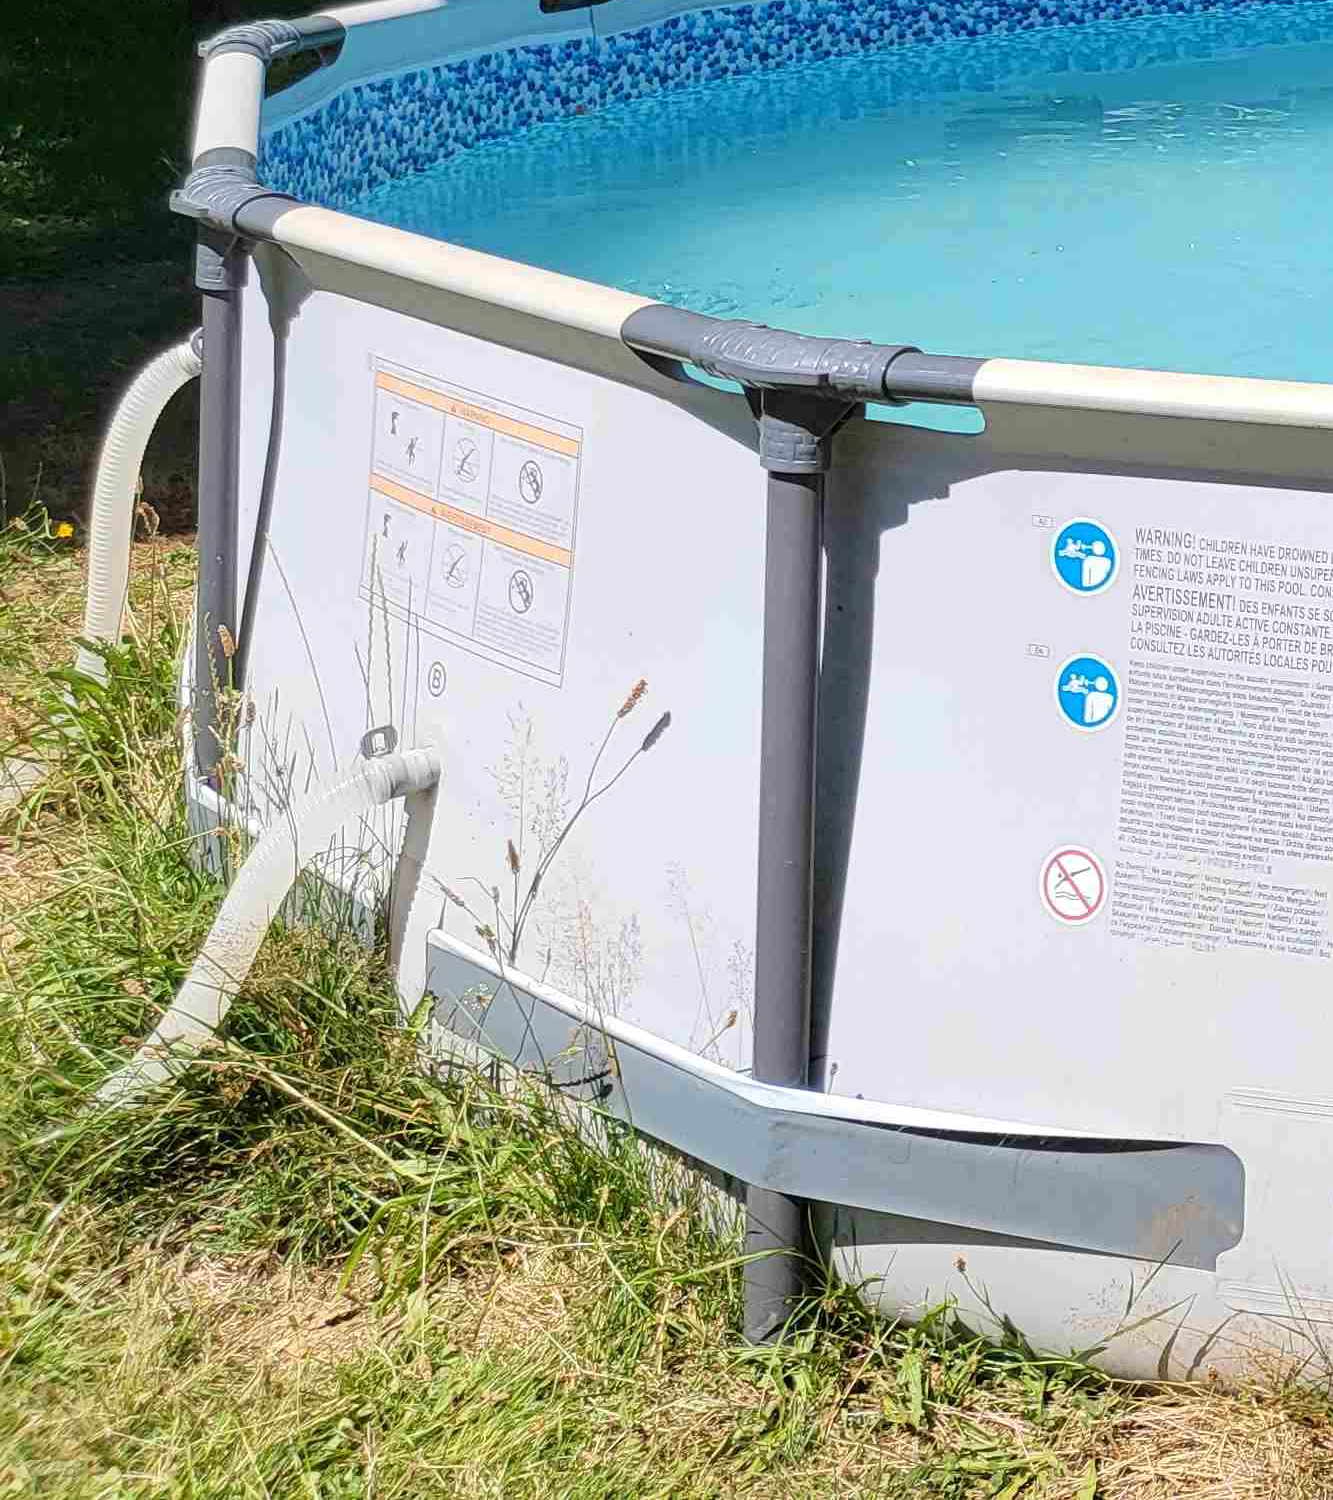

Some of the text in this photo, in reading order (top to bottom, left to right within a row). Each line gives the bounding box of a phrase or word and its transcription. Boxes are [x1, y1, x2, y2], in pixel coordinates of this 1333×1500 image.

[1135, 527, 1195, 550] WARNING!
[1200, 538, 1247, 555] CHILDREN
[1250, 543, 1275, 558] HAVE
[1278, 546, 1328, 564] DROWNED
[1133, 564, 1175, 582] FENCING
[1177, 569, 1203, 585] LAWS
[1206, 572, 1236, 588] APPLY
[1239, 576, 1251, 590] TO
[1255, 577, 1276, 592] THIS
[1167, 550, 1181, 564] DO
[1183, 552, 1203, 567] NOT
[1206, 554, 1236, 570] LEAVE
[1239, 558, 1288, 576] CHILDREN
[1131, 603, 1194, 623] SUPERVISION
[1196, 610, 1233, 627] ADULTE
[1235, 615, 1269, 631] ACTIVE
[1132, 583, 1236, 611] AVERTISSEMENT!
[1239, 599, 1258, 614] DES
[1261, 602, 1305, 619] ENFANTS
[1308, 606, 1320, 621] SE
[1130, 619, 1143, 633] LA
[1145, 621, 1181, 637] PISCINE
[1190, 626, 1250, 645] GARDEZ-LES
[1262, 634, 1300, 651] PORTER
[1303, 639, 1317, 653] DE
[1129, 637, 1185, 656] CONSULTEZ
[1187, 643, 1205, 658] LES
[1264, 652, 1309, 670] LOCALES
